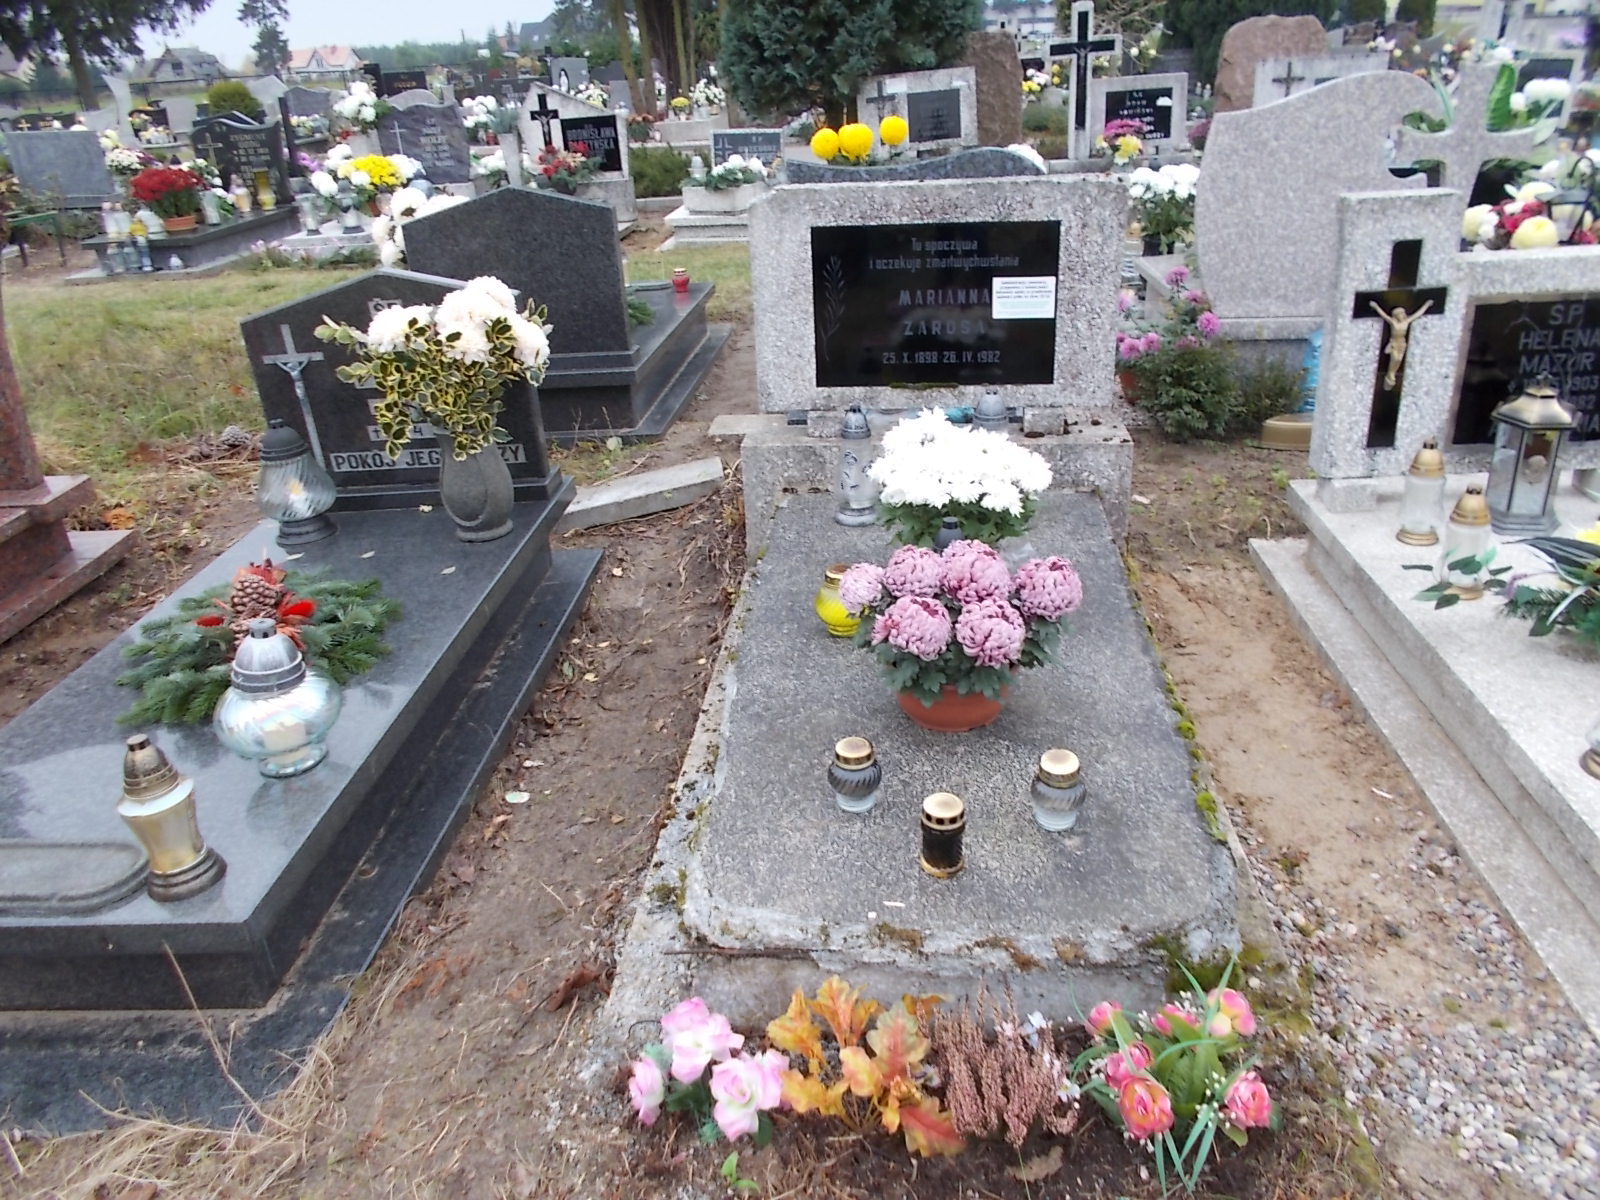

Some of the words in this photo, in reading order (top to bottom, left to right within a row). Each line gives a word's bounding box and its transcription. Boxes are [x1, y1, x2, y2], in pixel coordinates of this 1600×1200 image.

[912, 237, 922, 251] Tu
[925, 240, 978, 255] spoczywa
[875, 255, 921, 272] oczekuje
[899, 288, 990, 306] MARIANNA
[1519, 328, 1600, 350] HELENA
[405, 449, 441, 468] JEG
